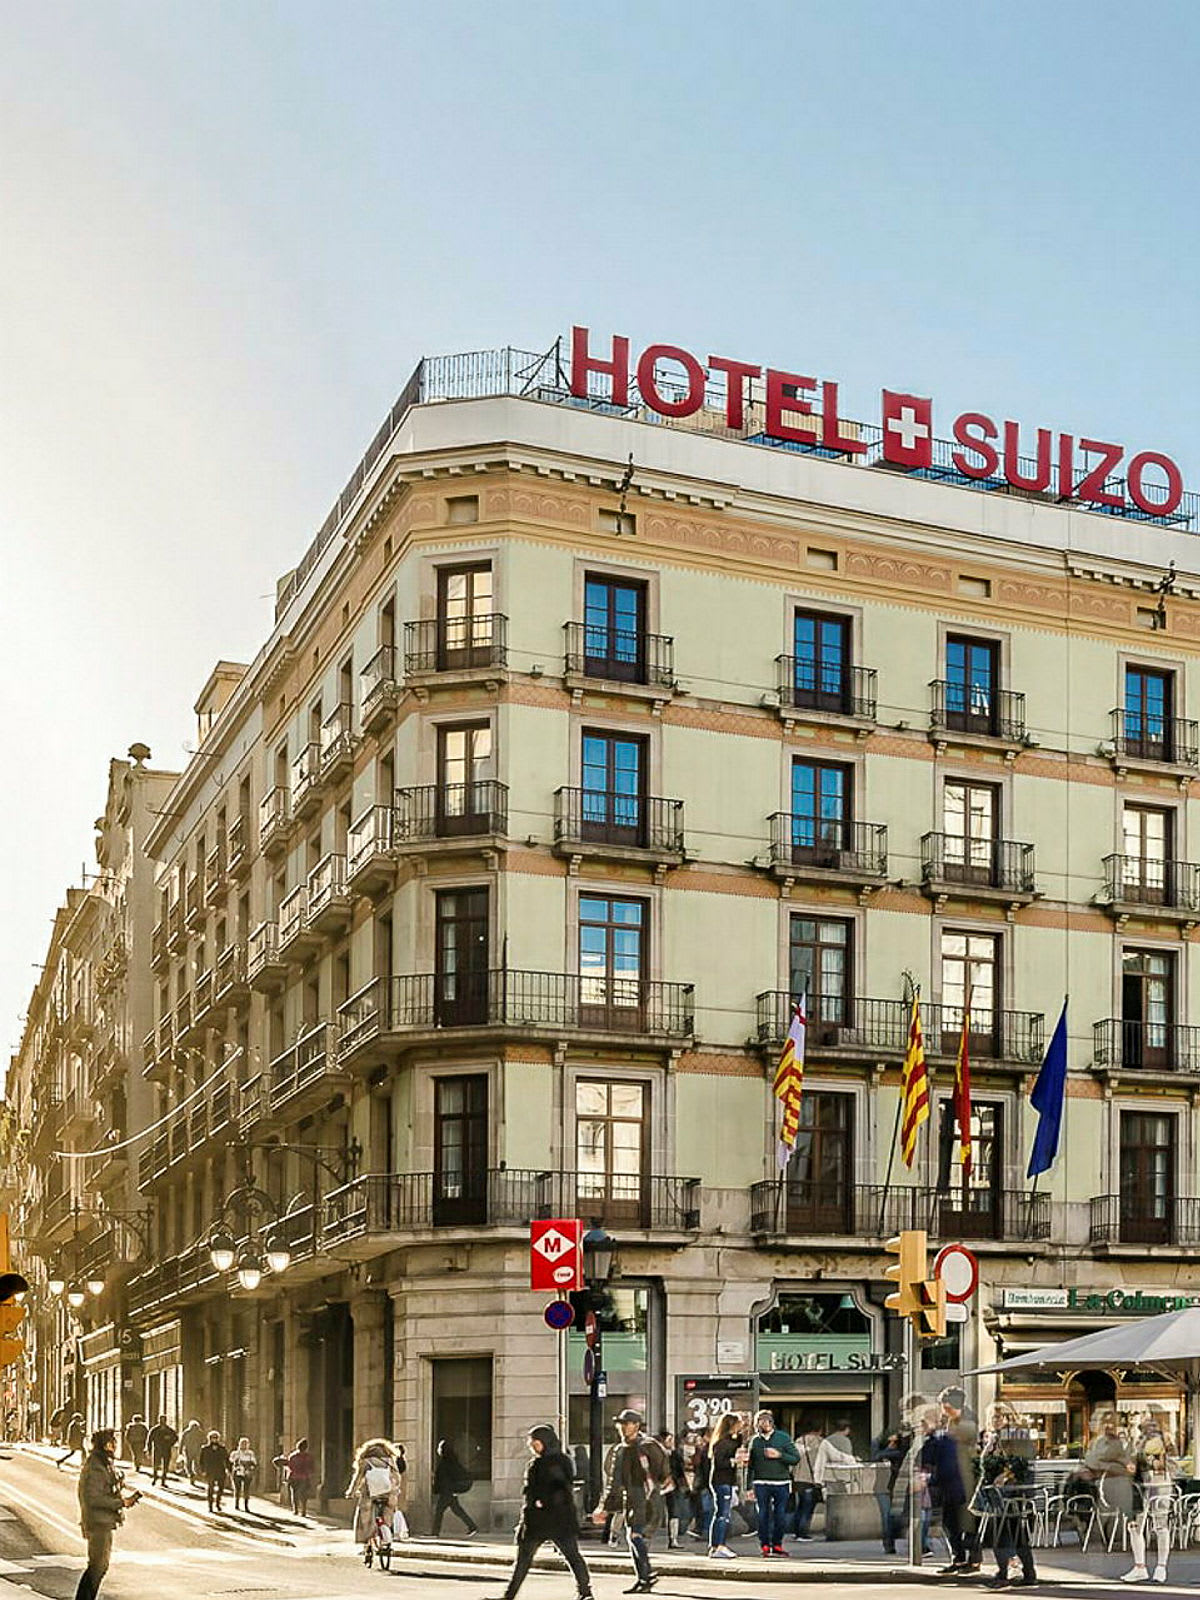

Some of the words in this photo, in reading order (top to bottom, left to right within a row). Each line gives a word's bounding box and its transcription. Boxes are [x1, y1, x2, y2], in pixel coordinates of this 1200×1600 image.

[570, 325, 868, 456] HOTEL
[951, 412, 1185, 517] SUIZO
[544, 1237, 561, 1253] M
[770, 1351, 840, 1371] HOTEL
